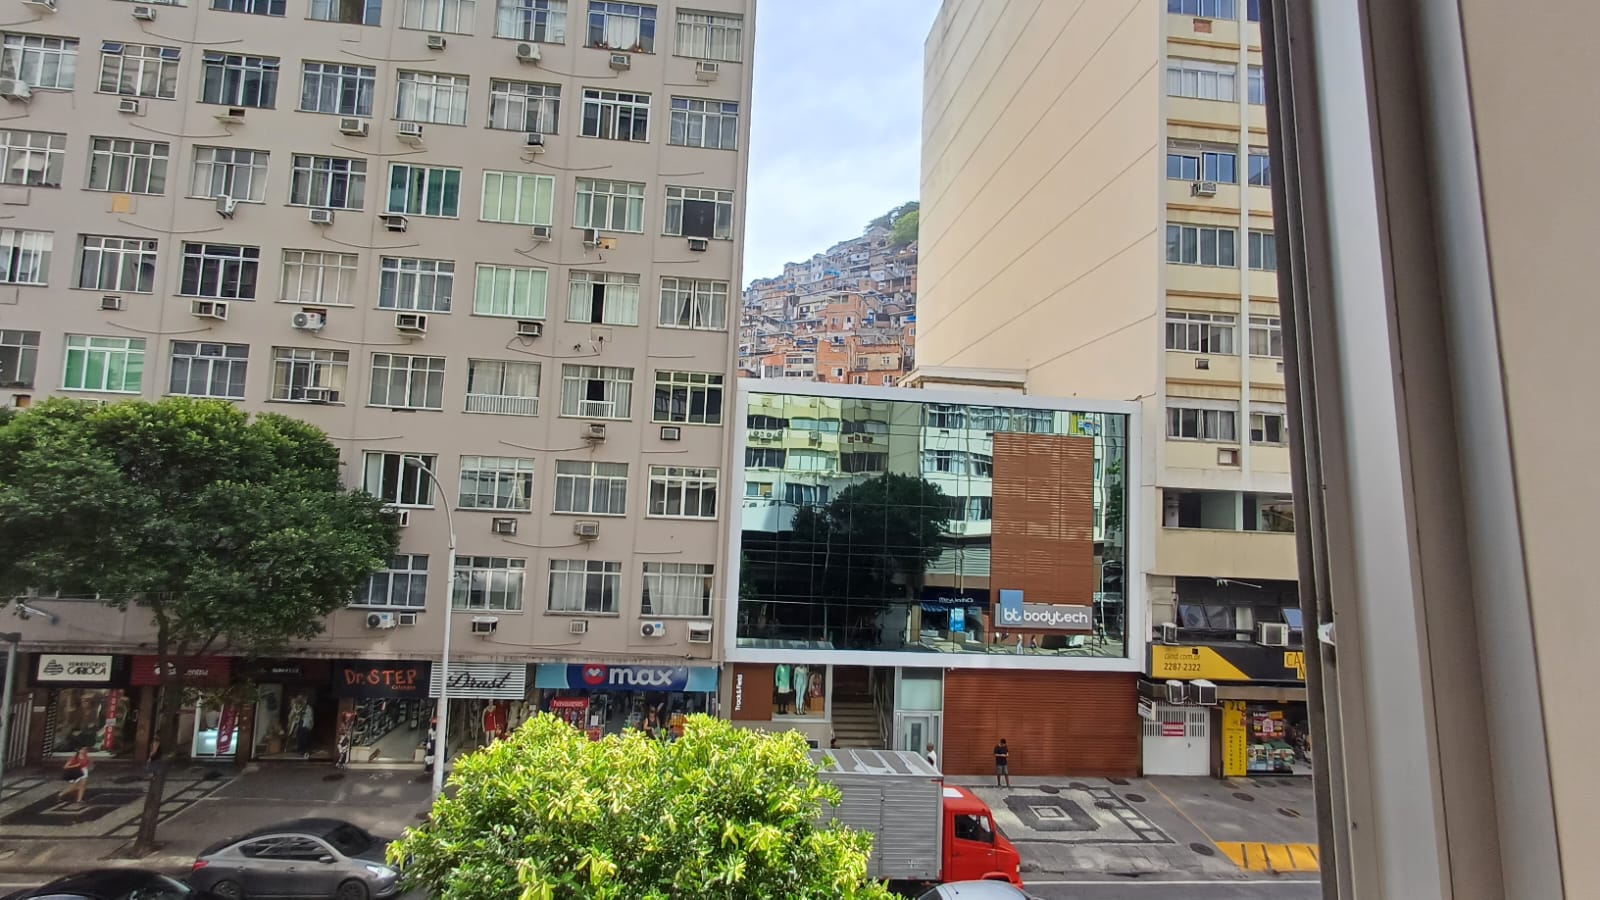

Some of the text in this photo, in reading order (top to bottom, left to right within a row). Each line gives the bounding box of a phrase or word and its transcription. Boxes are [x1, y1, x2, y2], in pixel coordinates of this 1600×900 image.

[1004, 608, 1088, 625] bt bodytech
[67, 665, 106, 676] CARIOCA
[609, 668, 672, 686] max
